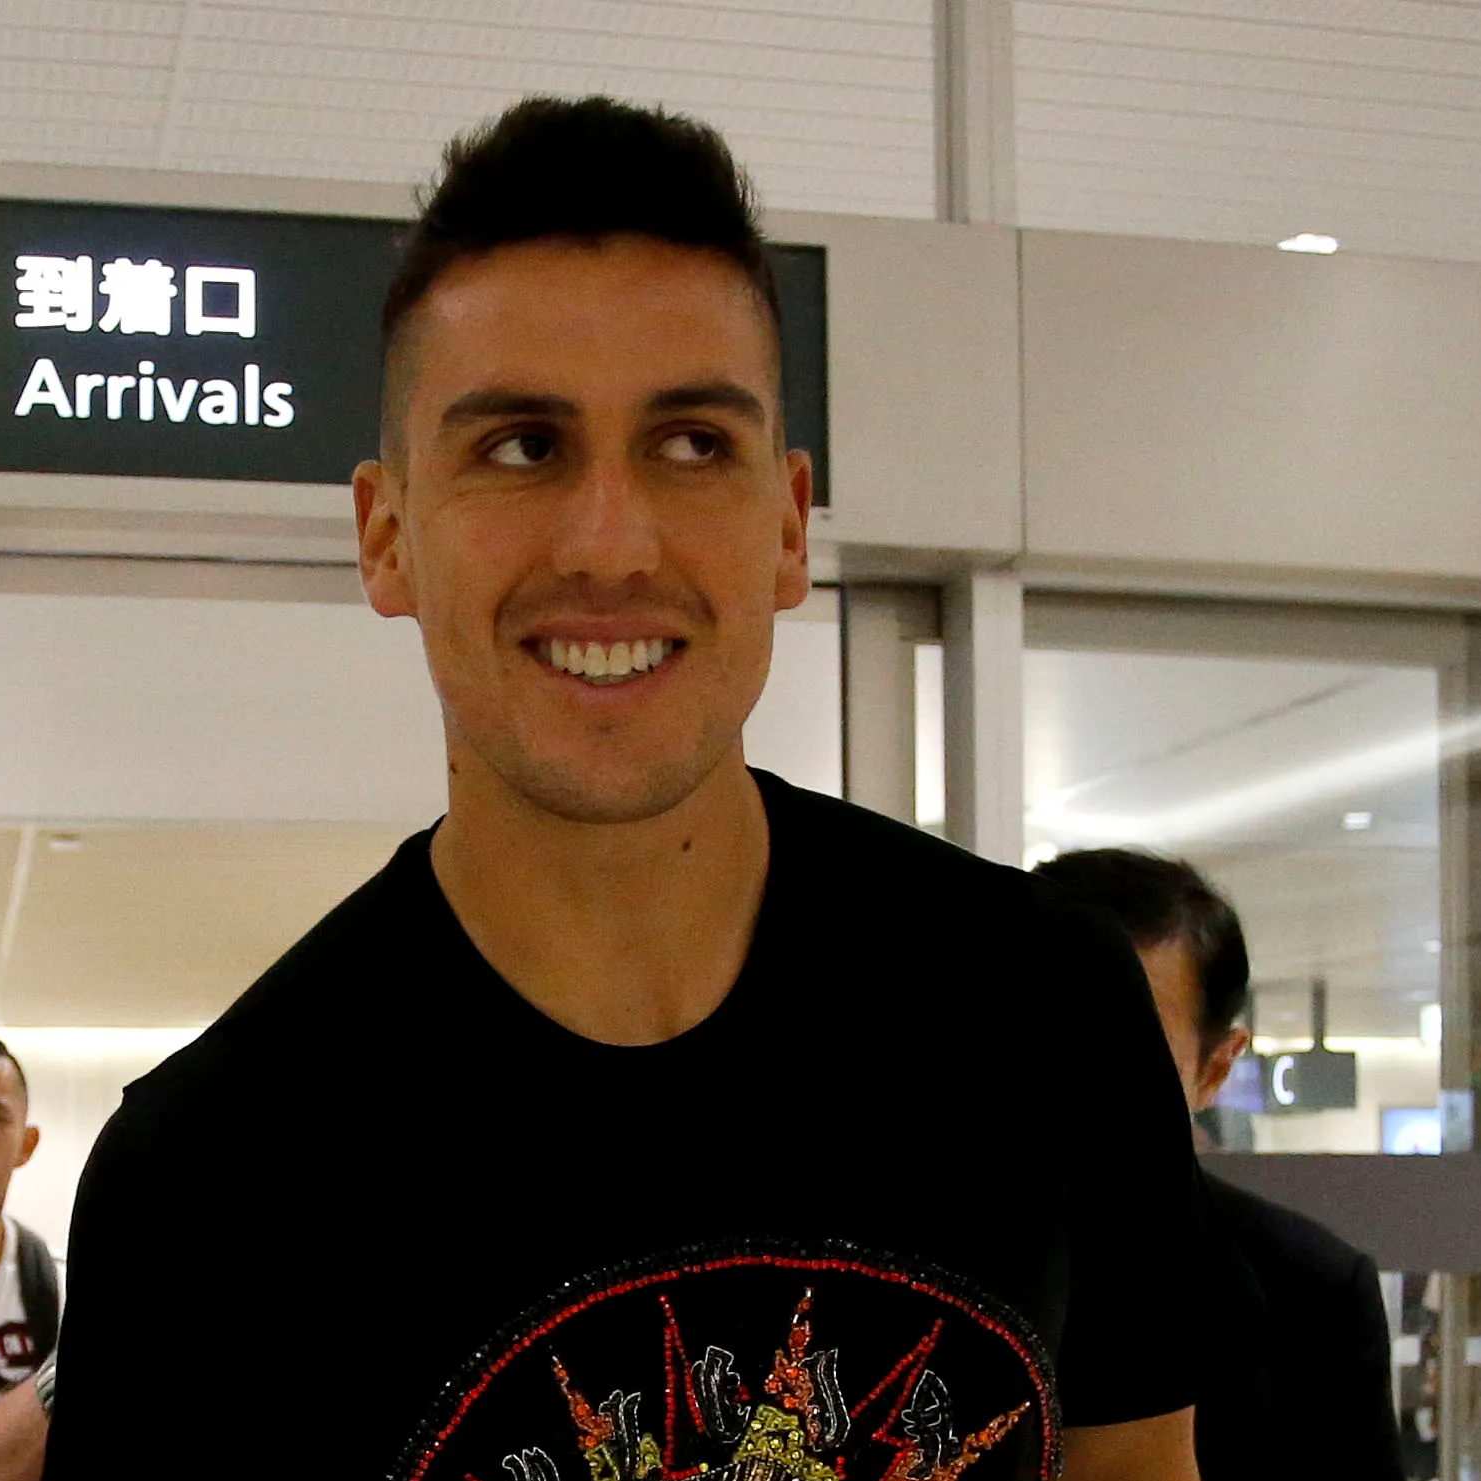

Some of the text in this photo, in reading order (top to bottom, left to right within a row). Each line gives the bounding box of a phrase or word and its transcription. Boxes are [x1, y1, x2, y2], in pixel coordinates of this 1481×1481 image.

[14, 254, 256, 338] 到着口
[14, 358, 296, 428] Arrivals
